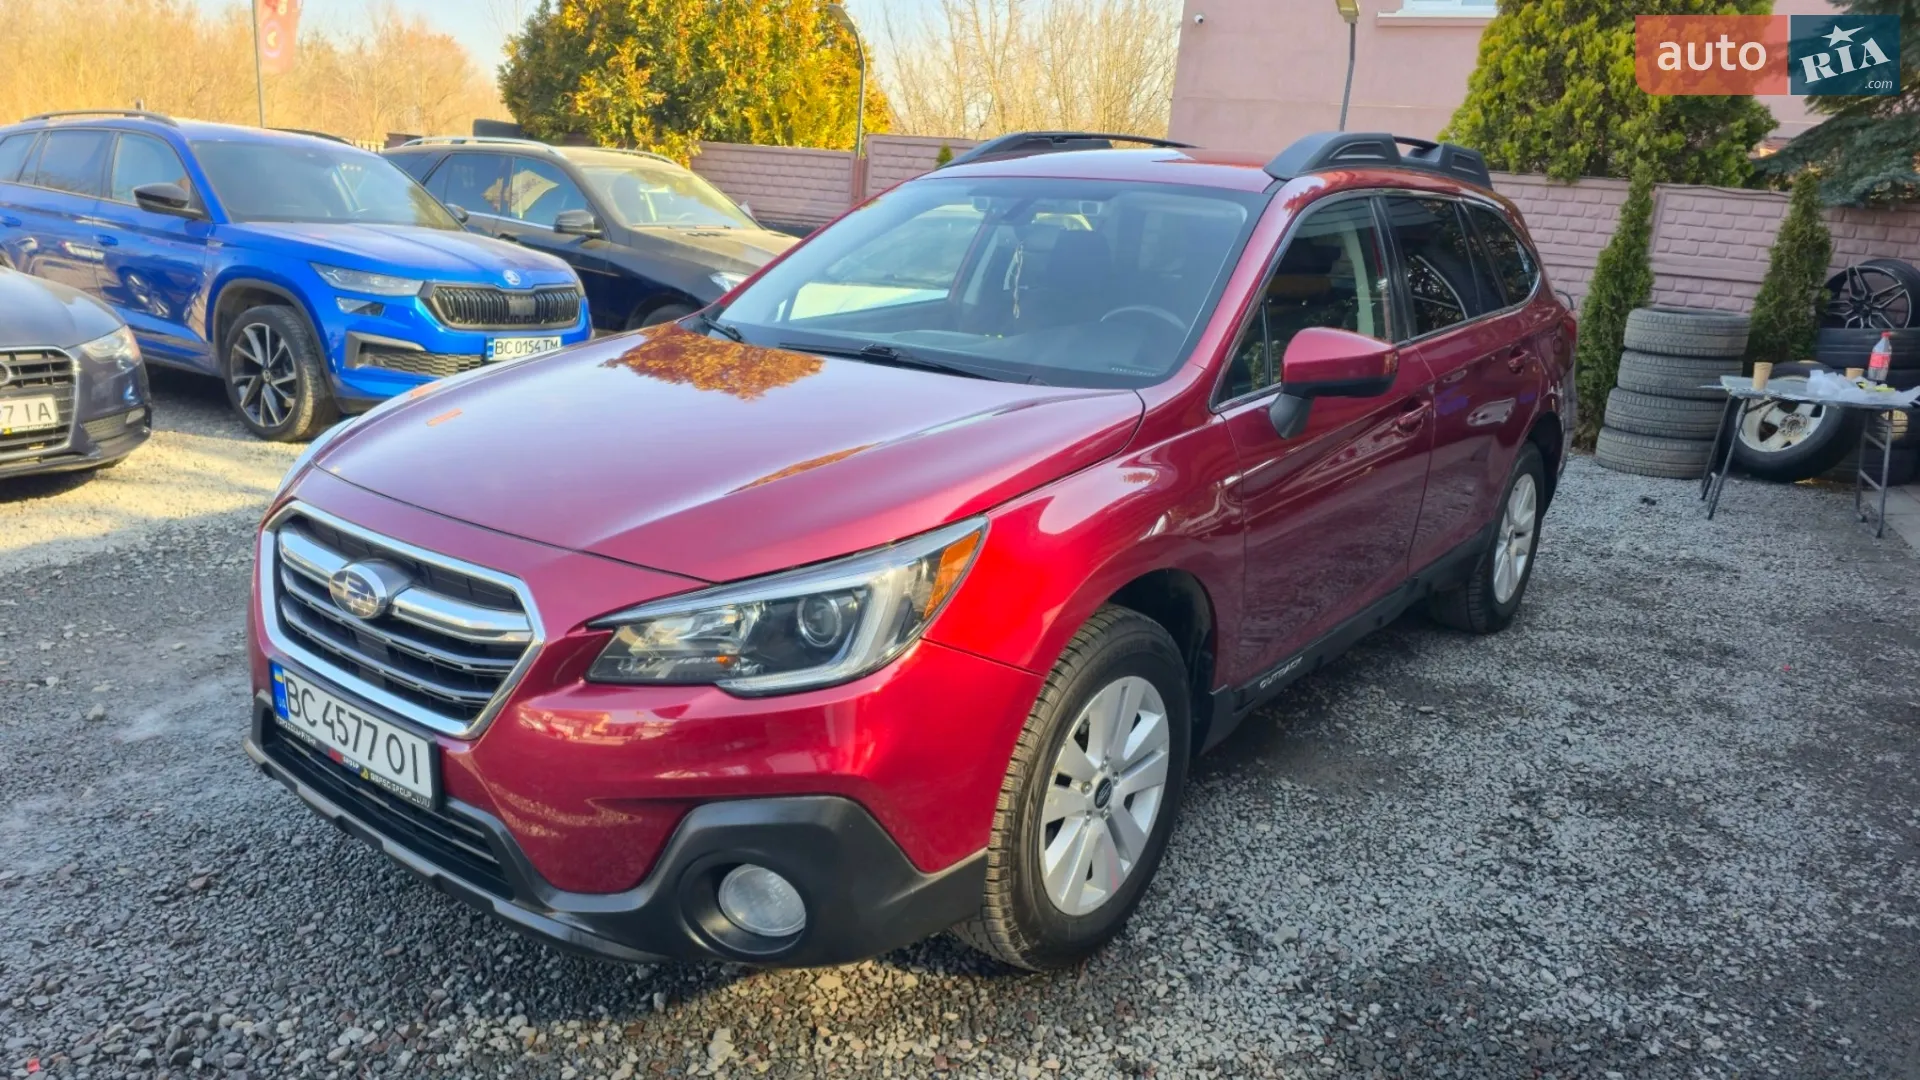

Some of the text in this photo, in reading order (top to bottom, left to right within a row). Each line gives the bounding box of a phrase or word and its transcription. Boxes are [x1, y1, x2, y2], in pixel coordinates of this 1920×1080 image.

[495, 339, 558, 355] BC 0154 TM
[285, 675, 317, 728] BC
[322, 700, 379, 761] 4577
[386, 733, 419, 785] OI
